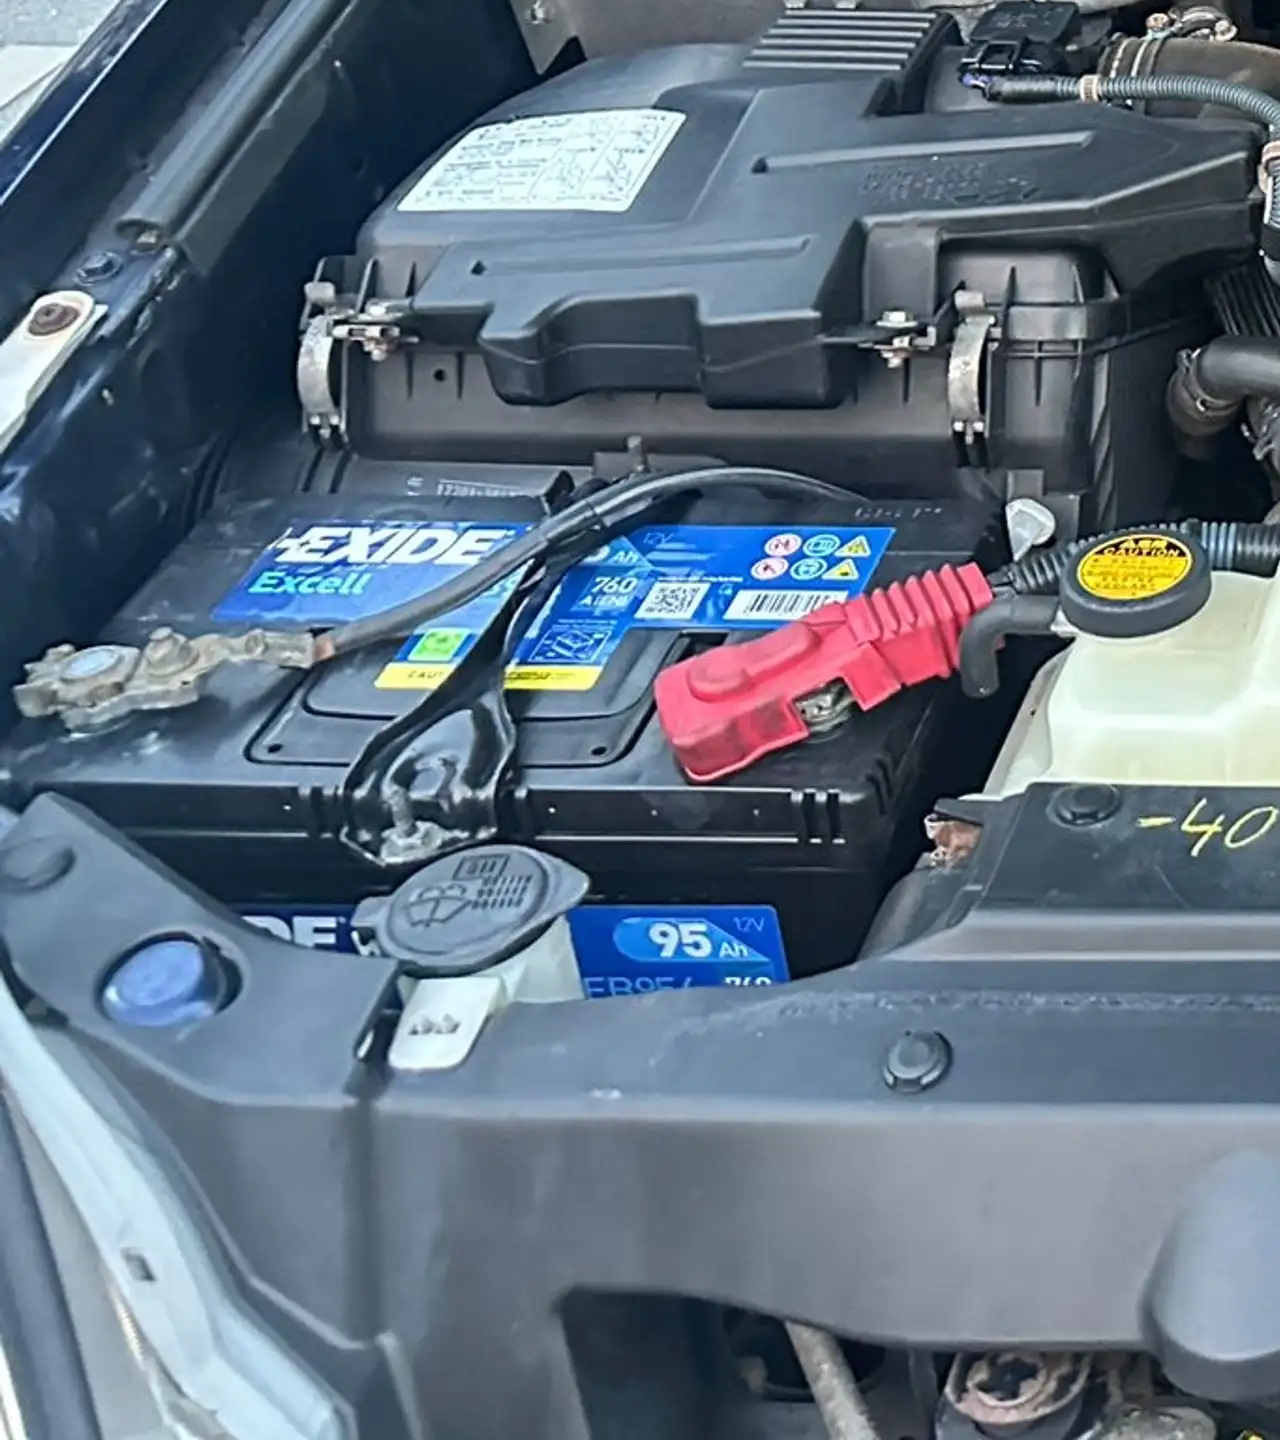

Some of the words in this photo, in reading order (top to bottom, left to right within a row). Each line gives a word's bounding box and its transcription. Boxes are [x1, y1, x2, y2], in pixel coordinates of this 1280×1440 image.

[271, 526, 509, 565] EXIDE
[1103, 546, 1180, 558] CAUTION
[248, 570, 373, 595] Excell
[592, 576, 638, 594] 760
[734, 916, 765, 933] 12V
[649, 921, 711, 959] 95
[719, 942, 749, 960] Ah
